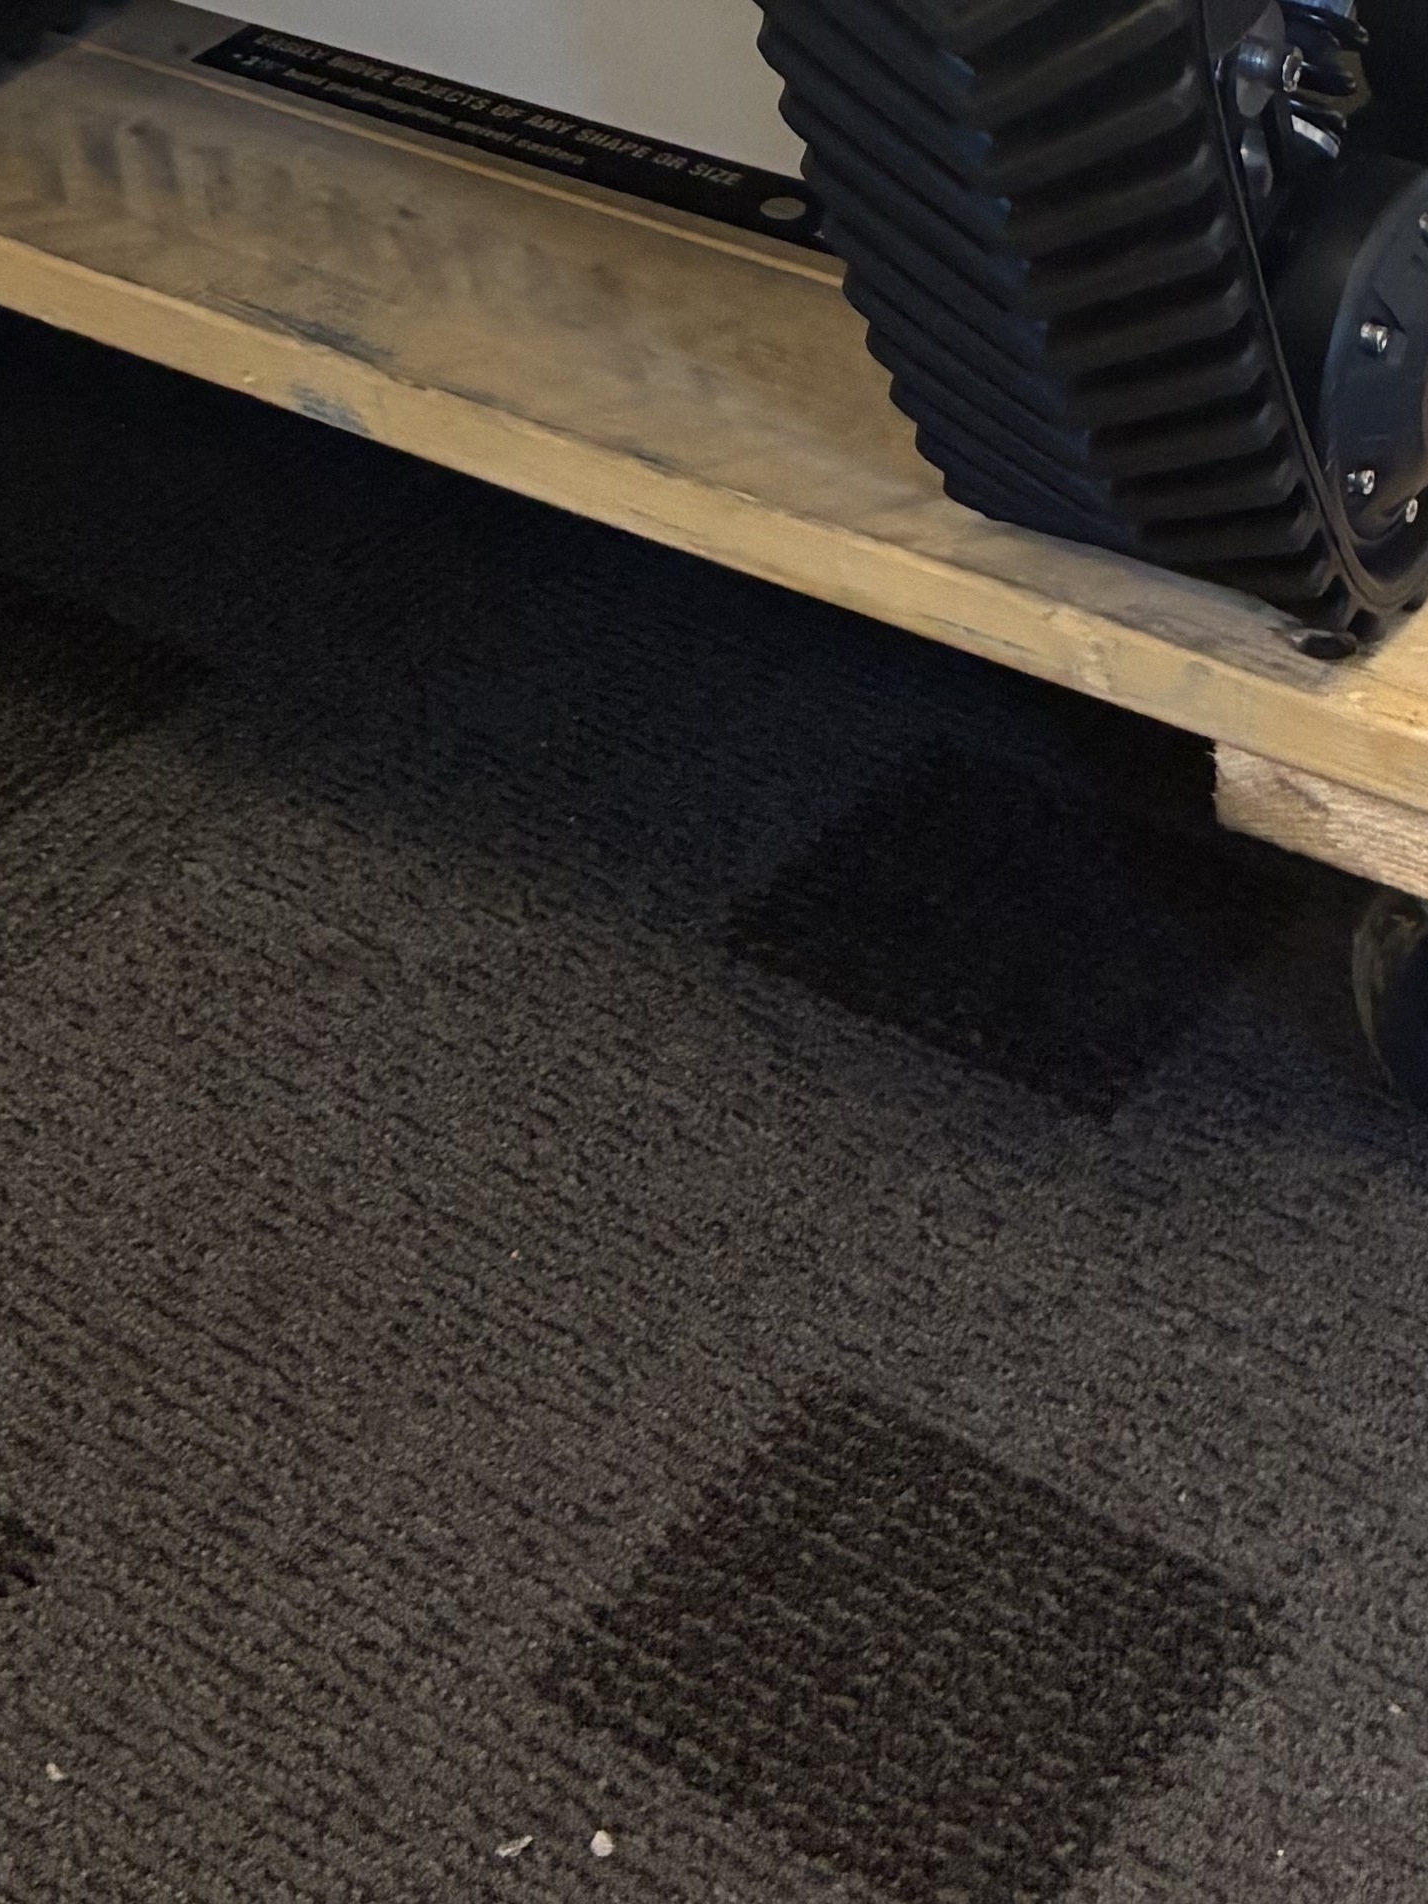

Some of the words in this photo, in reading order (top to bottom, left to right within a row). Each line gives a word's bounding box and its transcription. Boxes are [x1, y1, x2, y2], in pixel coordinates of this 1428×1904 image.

[391, 75, 493, 112] OBJECTS
[491, 103, 526, 120] OF
[524, 114, 579, 136] ANY
[574, 128, 654, 160] SHAPE
[652, 151, 689, 172] OR
[688, 162, 746, 187] SIZE
